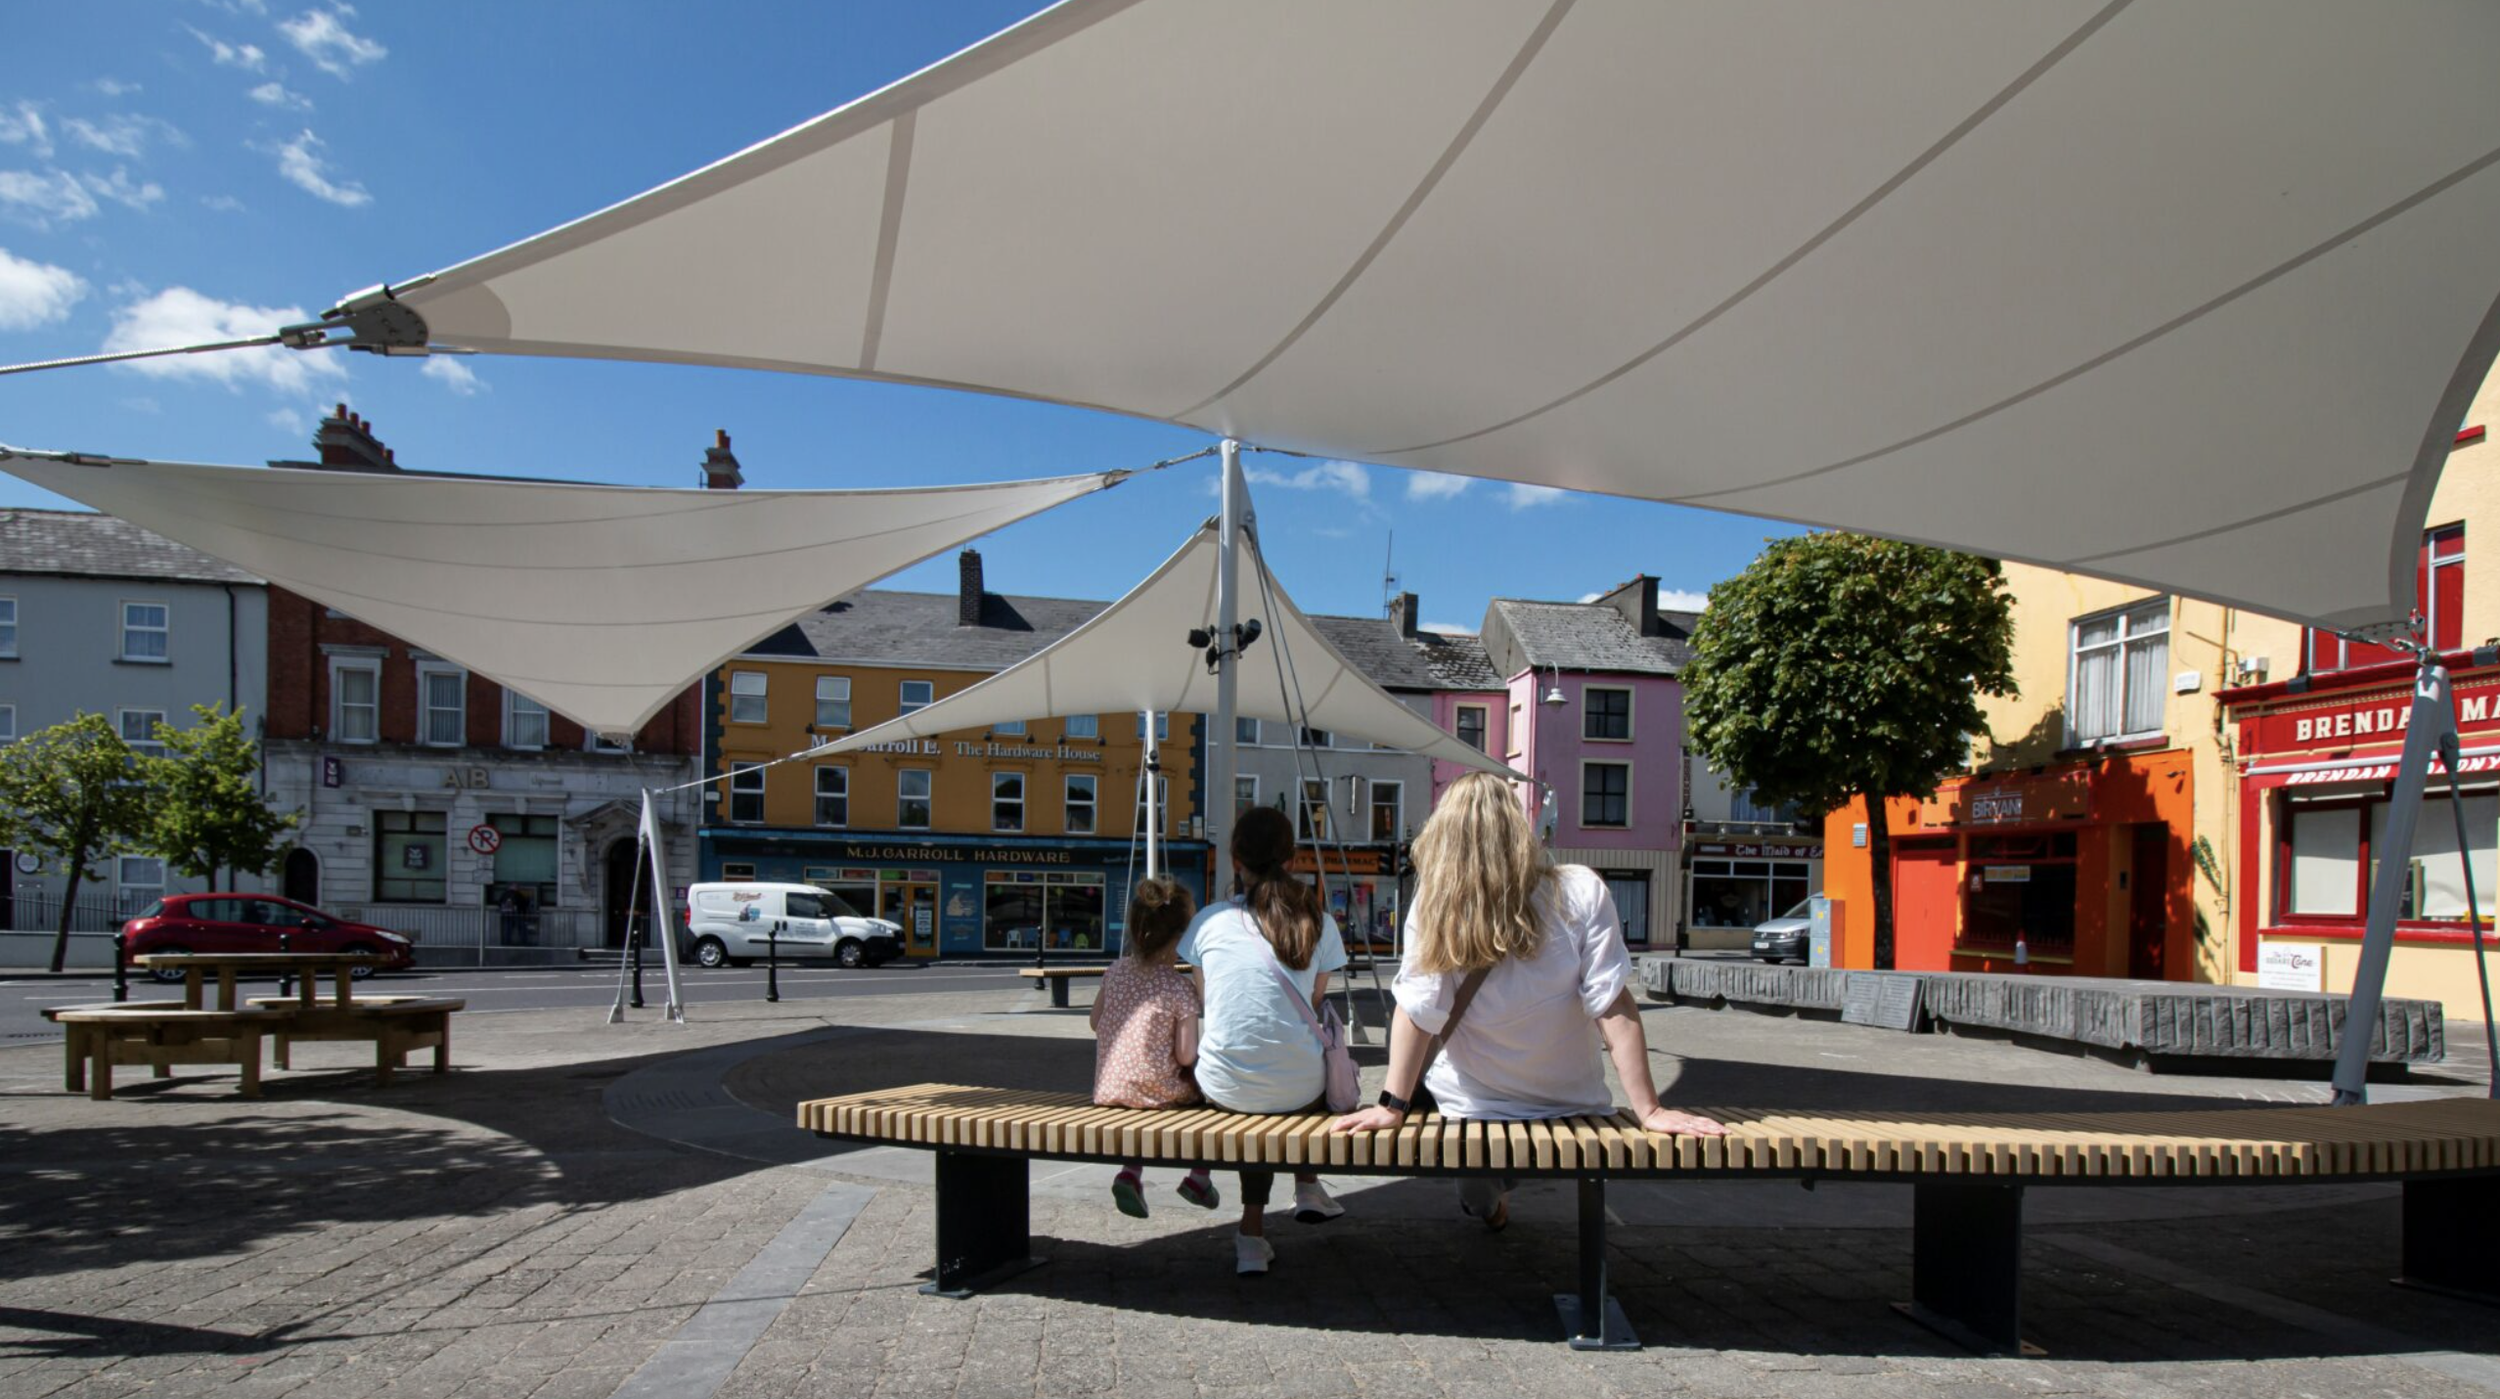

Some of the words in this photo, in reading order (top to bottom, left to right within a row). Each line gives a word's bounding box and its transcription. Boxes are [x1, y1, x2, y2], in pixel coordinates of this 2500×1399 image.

[2296, 705, 2412, 742] BRENDA
[858, 738, 919, 754] arroll
[954, 741, 984, 757] The
[987, 742, 1053, 759] Hardware
[1058, 745, 1101, 762] House
[444, 767, 489, 789] AIB
[2285, 765, 2392, 785] BRENDAN
[1972, 798, 2022, 818] BIRYANI
[974, 850, 1070, 864] HARDWARE
[1735, 844, 1757, 857] The
[1761, 844, 1791, 857] Maid
[1794, 846, 1806, 858] of
